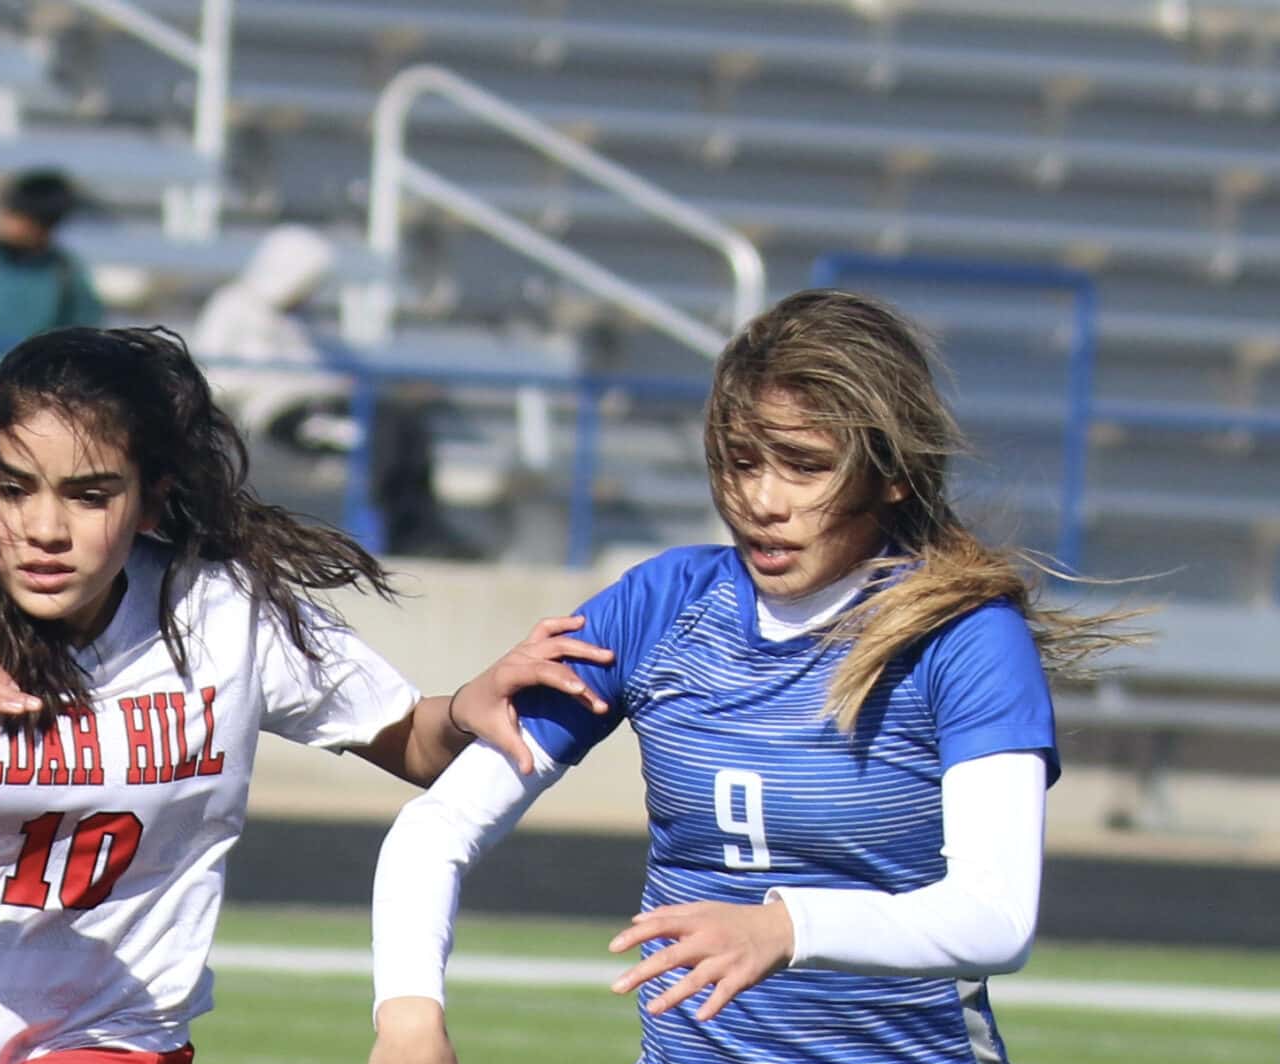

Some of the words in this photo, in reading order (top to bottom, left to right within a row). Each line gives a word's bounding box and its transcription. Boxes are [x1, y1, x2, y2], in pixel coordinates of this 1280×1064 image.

[118, 686, 225, 785] HILL
[1, 811, 143, 911] 10
[713, 768, 771, 870] 9
